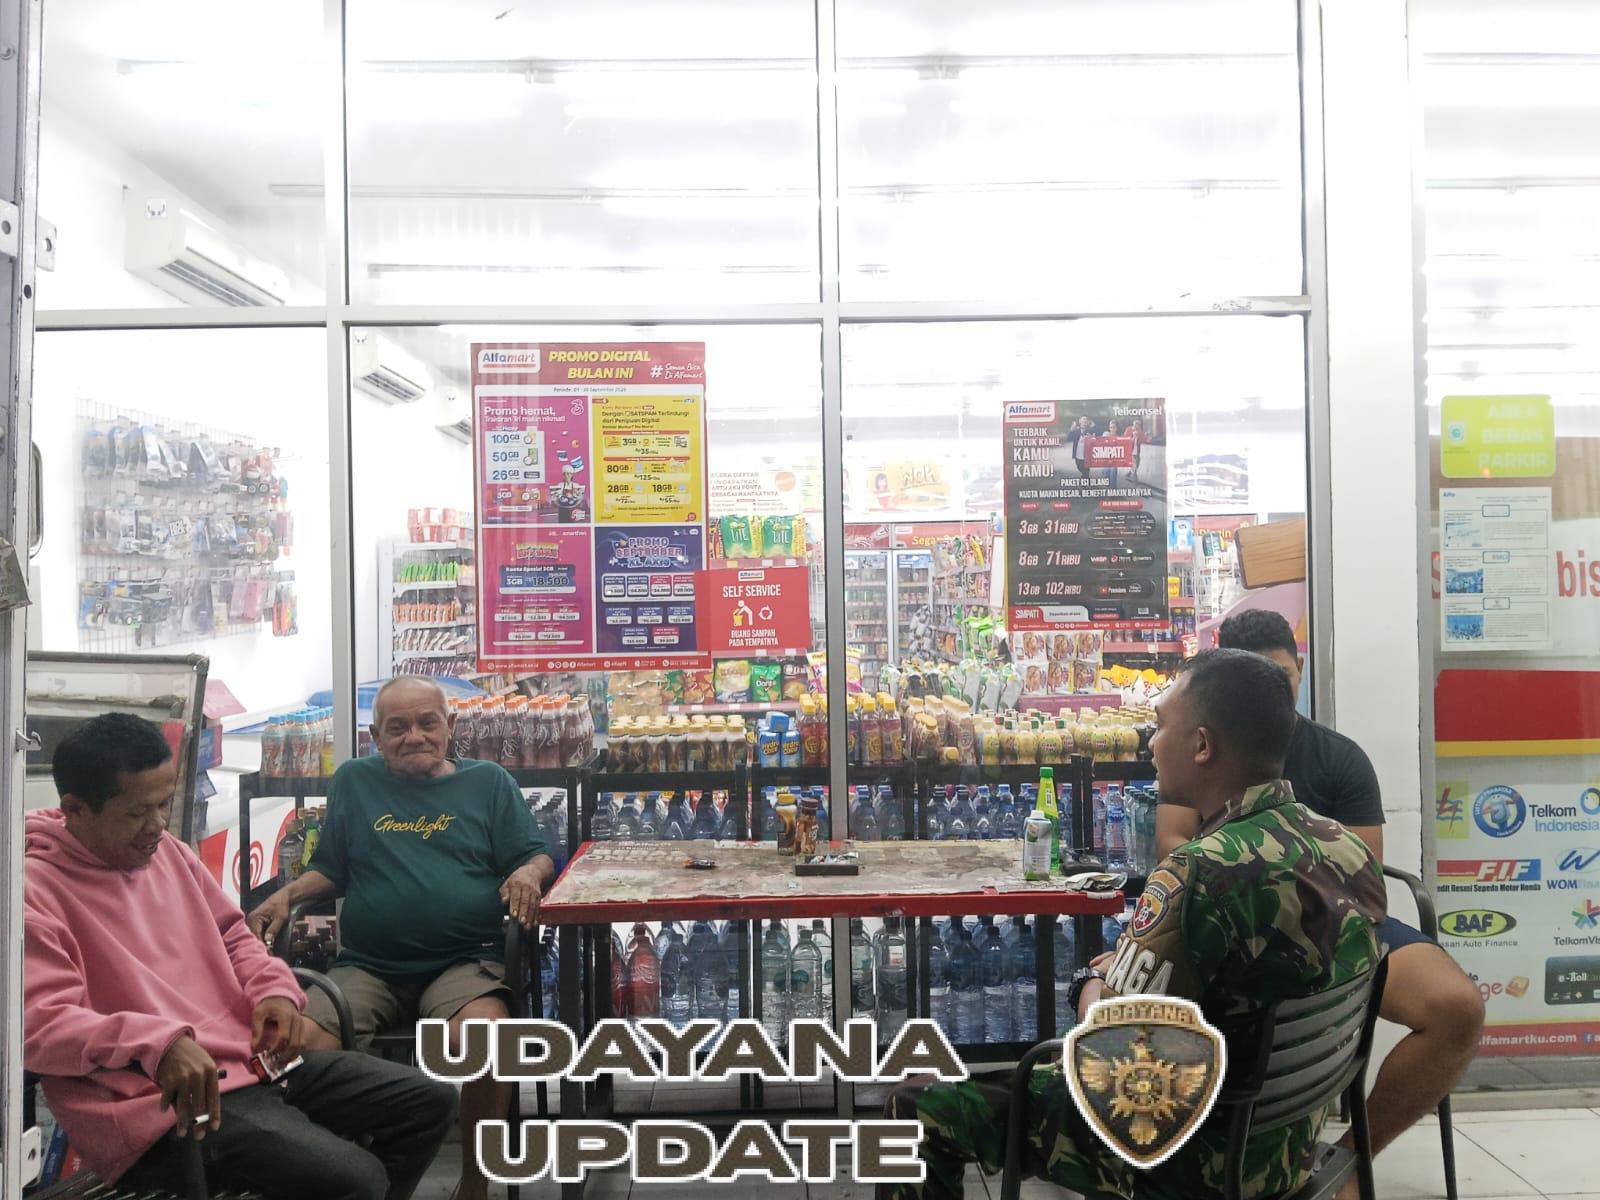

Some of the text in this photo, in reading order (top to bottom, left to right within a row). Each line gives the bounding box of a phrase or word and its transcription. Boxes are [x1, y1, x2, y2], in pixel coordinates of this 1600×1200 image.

[482, 352, 536, 363] Alfamart
[548, 350, 652, 362] PROMO DIGITAL
[567, 367, 634, 379] BULAN INI
[484, 406, 556, 417] Promo hemat,
[1008, 405, 1051, 414] Alfamart
[1112, 406, 1163, 417] Telkomsel
[1013, 428, 1048, 437] TERBAIK
[1013, 438, 1037, 447] UNTUK
[1013, 448, 1049, 461] KAMU
[1092, 446, 1125, 459] SIMPATI
[1013, 464, 1054, 477] KAMU!
[1060, 478, 1080, 487] PAKET
[1090, 478, 1109, 486] ULANG
[1039, 490, 1059, 498] MAKIN
[1082, 489, 1106, 498] BENEFIT
[1107, 488, 1127, 497] MAKIN
[1128, 487, 1152, 497] BANYAK
[628, 537, 670, 547] PROMO
[615, 547, 682, 558] SEPTEMBER
[628, 556, 671, 568] XL AXIS
[722, 584, 782, 598] SELF SERVICE
[1015, 609, 1039, 619] SIMPATI
[731, 629, 776, 638] BUANG SAMPAH
[728, 637, 779, 647] PADA TEMPATNYA
[1529, 804, 1577, 818] Telkom
[373, 813, 457, 840] Greenlight
[1534, 818, 1600, 833] Indonesia
[1450, 884, 1472, 892] Resmi
[1473, 884, 1498, 893] Sepeda
[1499, 884, 1519, 892] Motor
[1520, 883, 1541, 892] Honda
[1453, 913, 1494, 933] BAF
[1463, 940, 1482, 948] Auto
[1485, 939, 1518, 947] Finance
